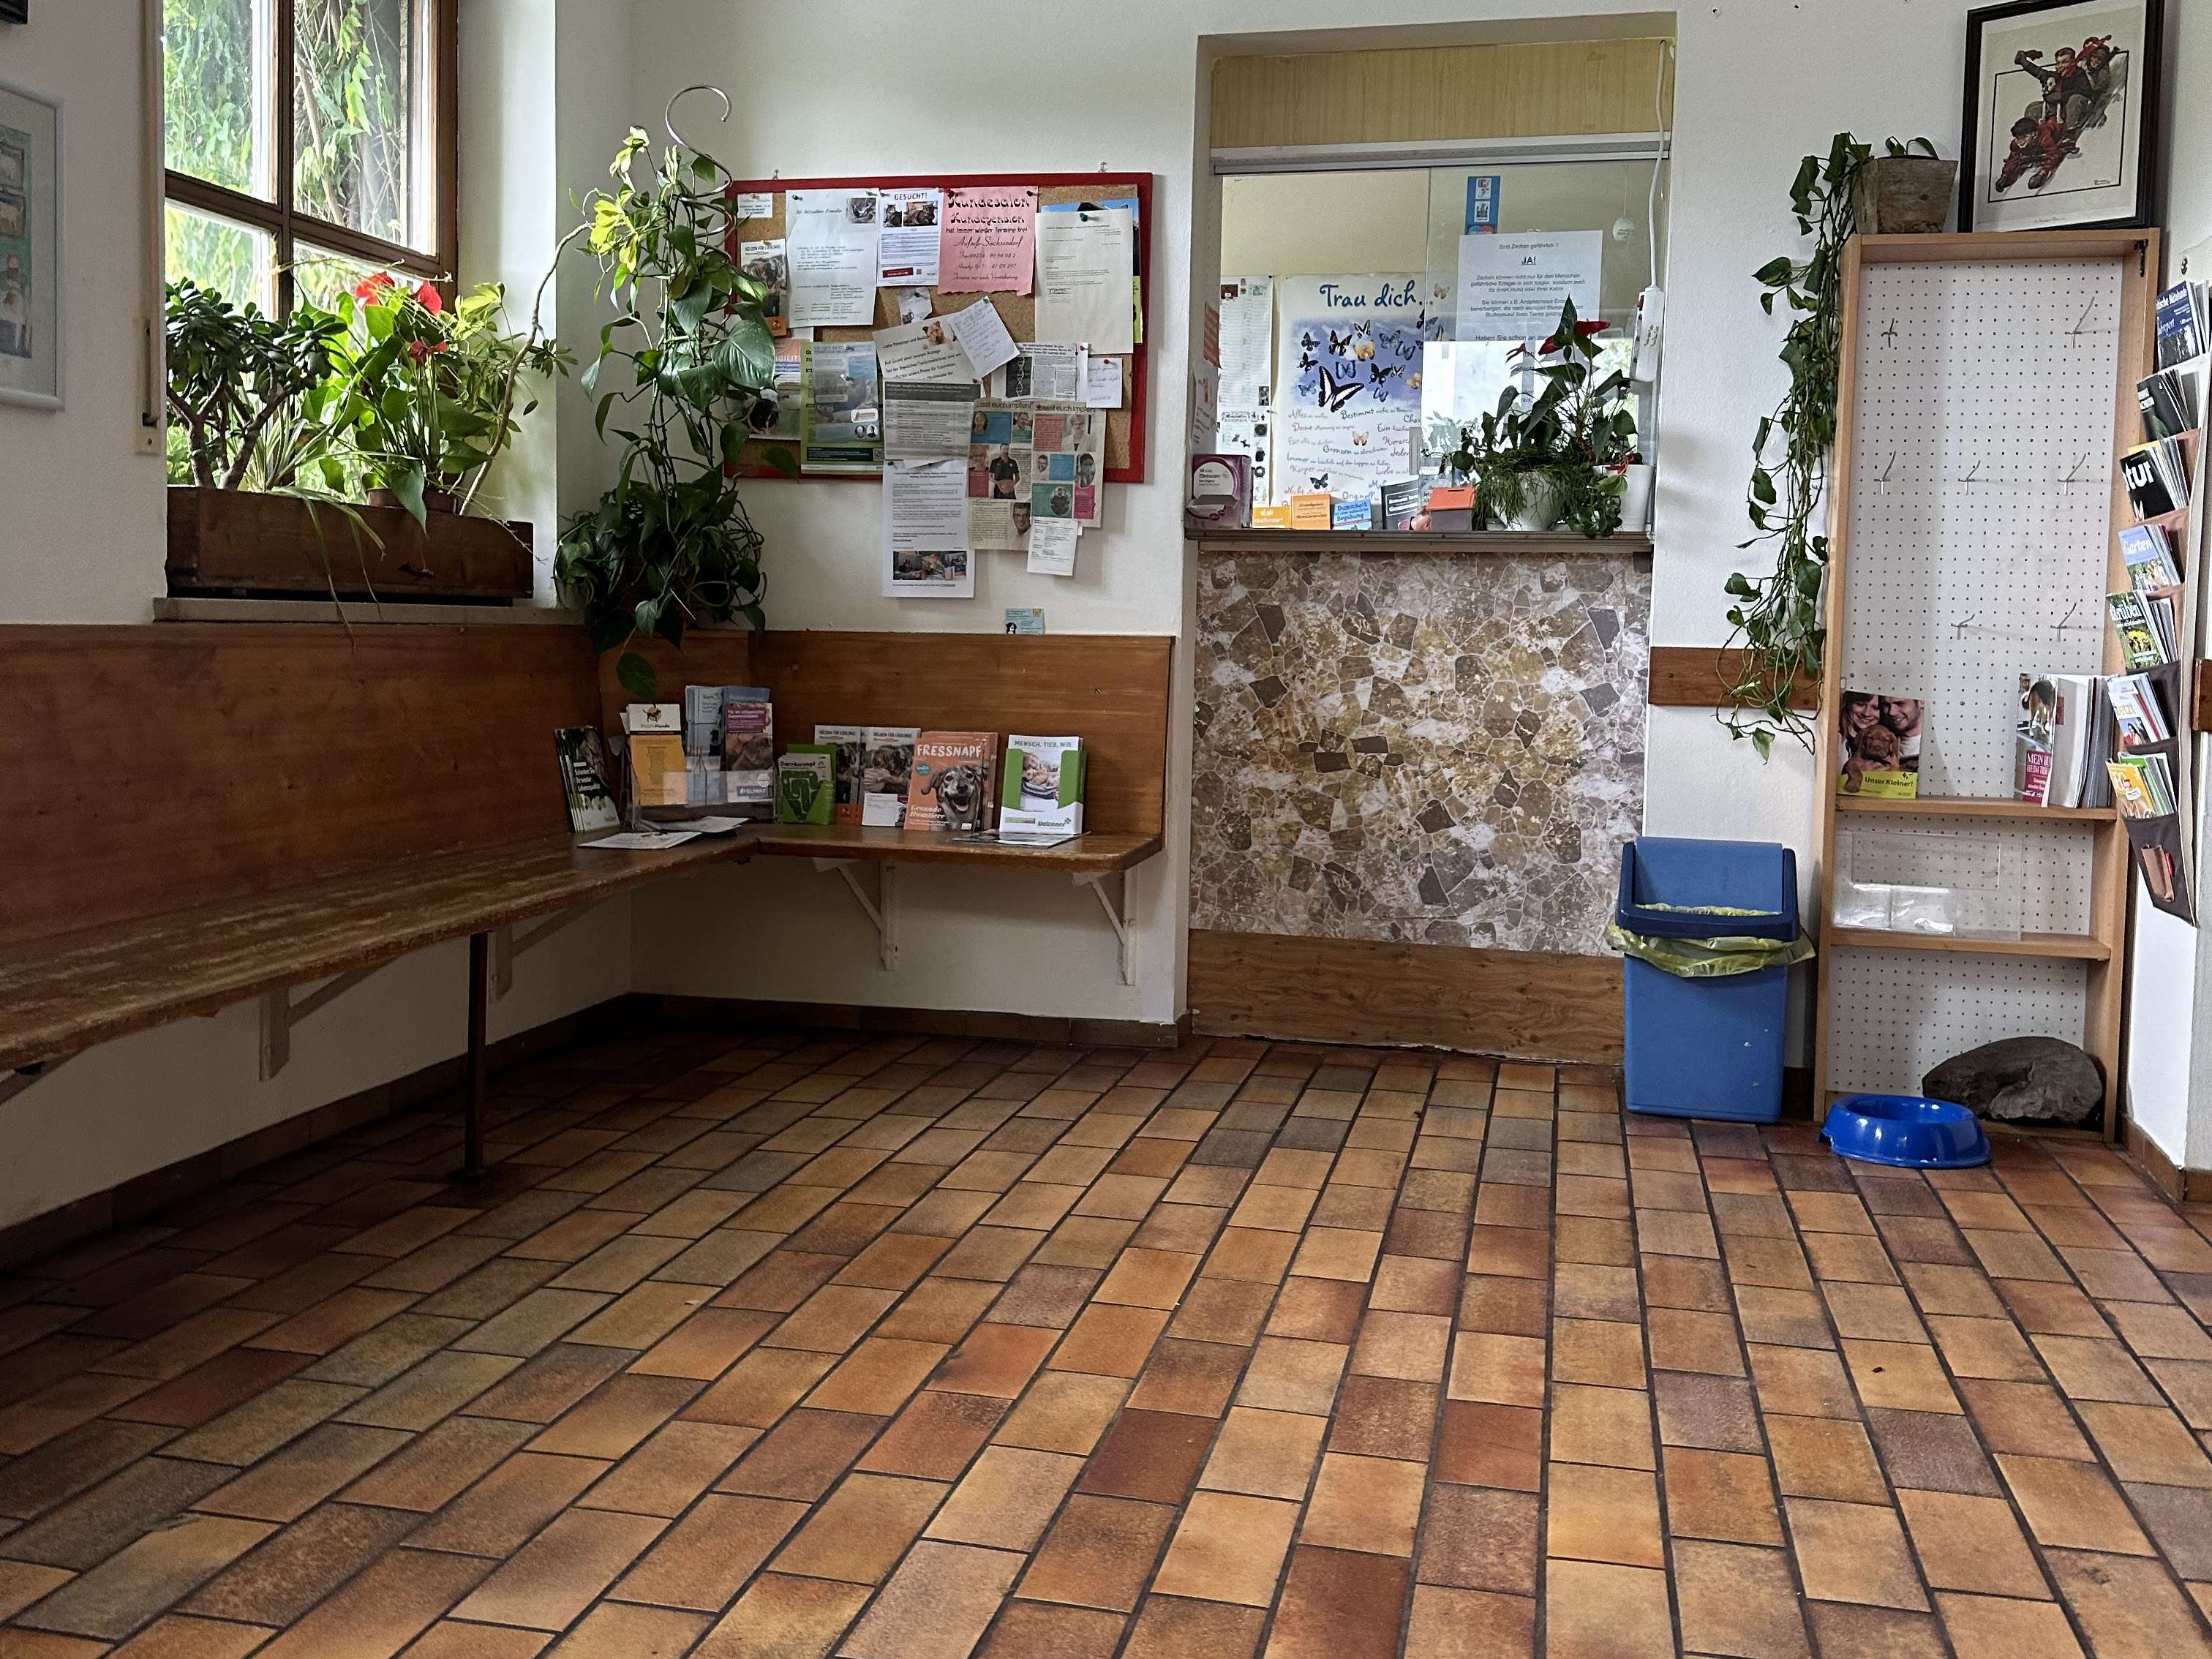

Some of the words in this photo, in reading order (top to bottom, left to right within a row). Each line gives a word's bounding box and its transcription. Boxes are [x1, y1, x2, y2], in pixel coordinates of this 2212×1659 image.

[894, 192, 928, 200] GESUCHT!
[948, 193, 1030, 208] Hundesalon
[950, 212, 1025, 226] Hundepension
[1521, 256, 1537, 265] JA!
[1320, 284, 1367, 307] Trau
[1056, 404, 1072, 412] euch
[1288, 409, 1306, 419] Alles
[1340, 408, 1374, 421] Bestimmt
[1292, 422, 1312, 432] Deine
[1377, 423, 1391, 432] Ein
[1288, 437, 1300, 445] Für
[1323, 445, 1352, 455] Grenzen
[1287, 452, 1309, 462] Immer
[1289, 465, 1315, 475] Körper
[2123, 539, 2153, 554] Garten
[917, 744, 982, 758] FRESSNAPF
[2027, 753, 2044, 765] MEIN
[1865, 776, 1884, 785] Unser
[911, 805, 942, 813] Gesunde
